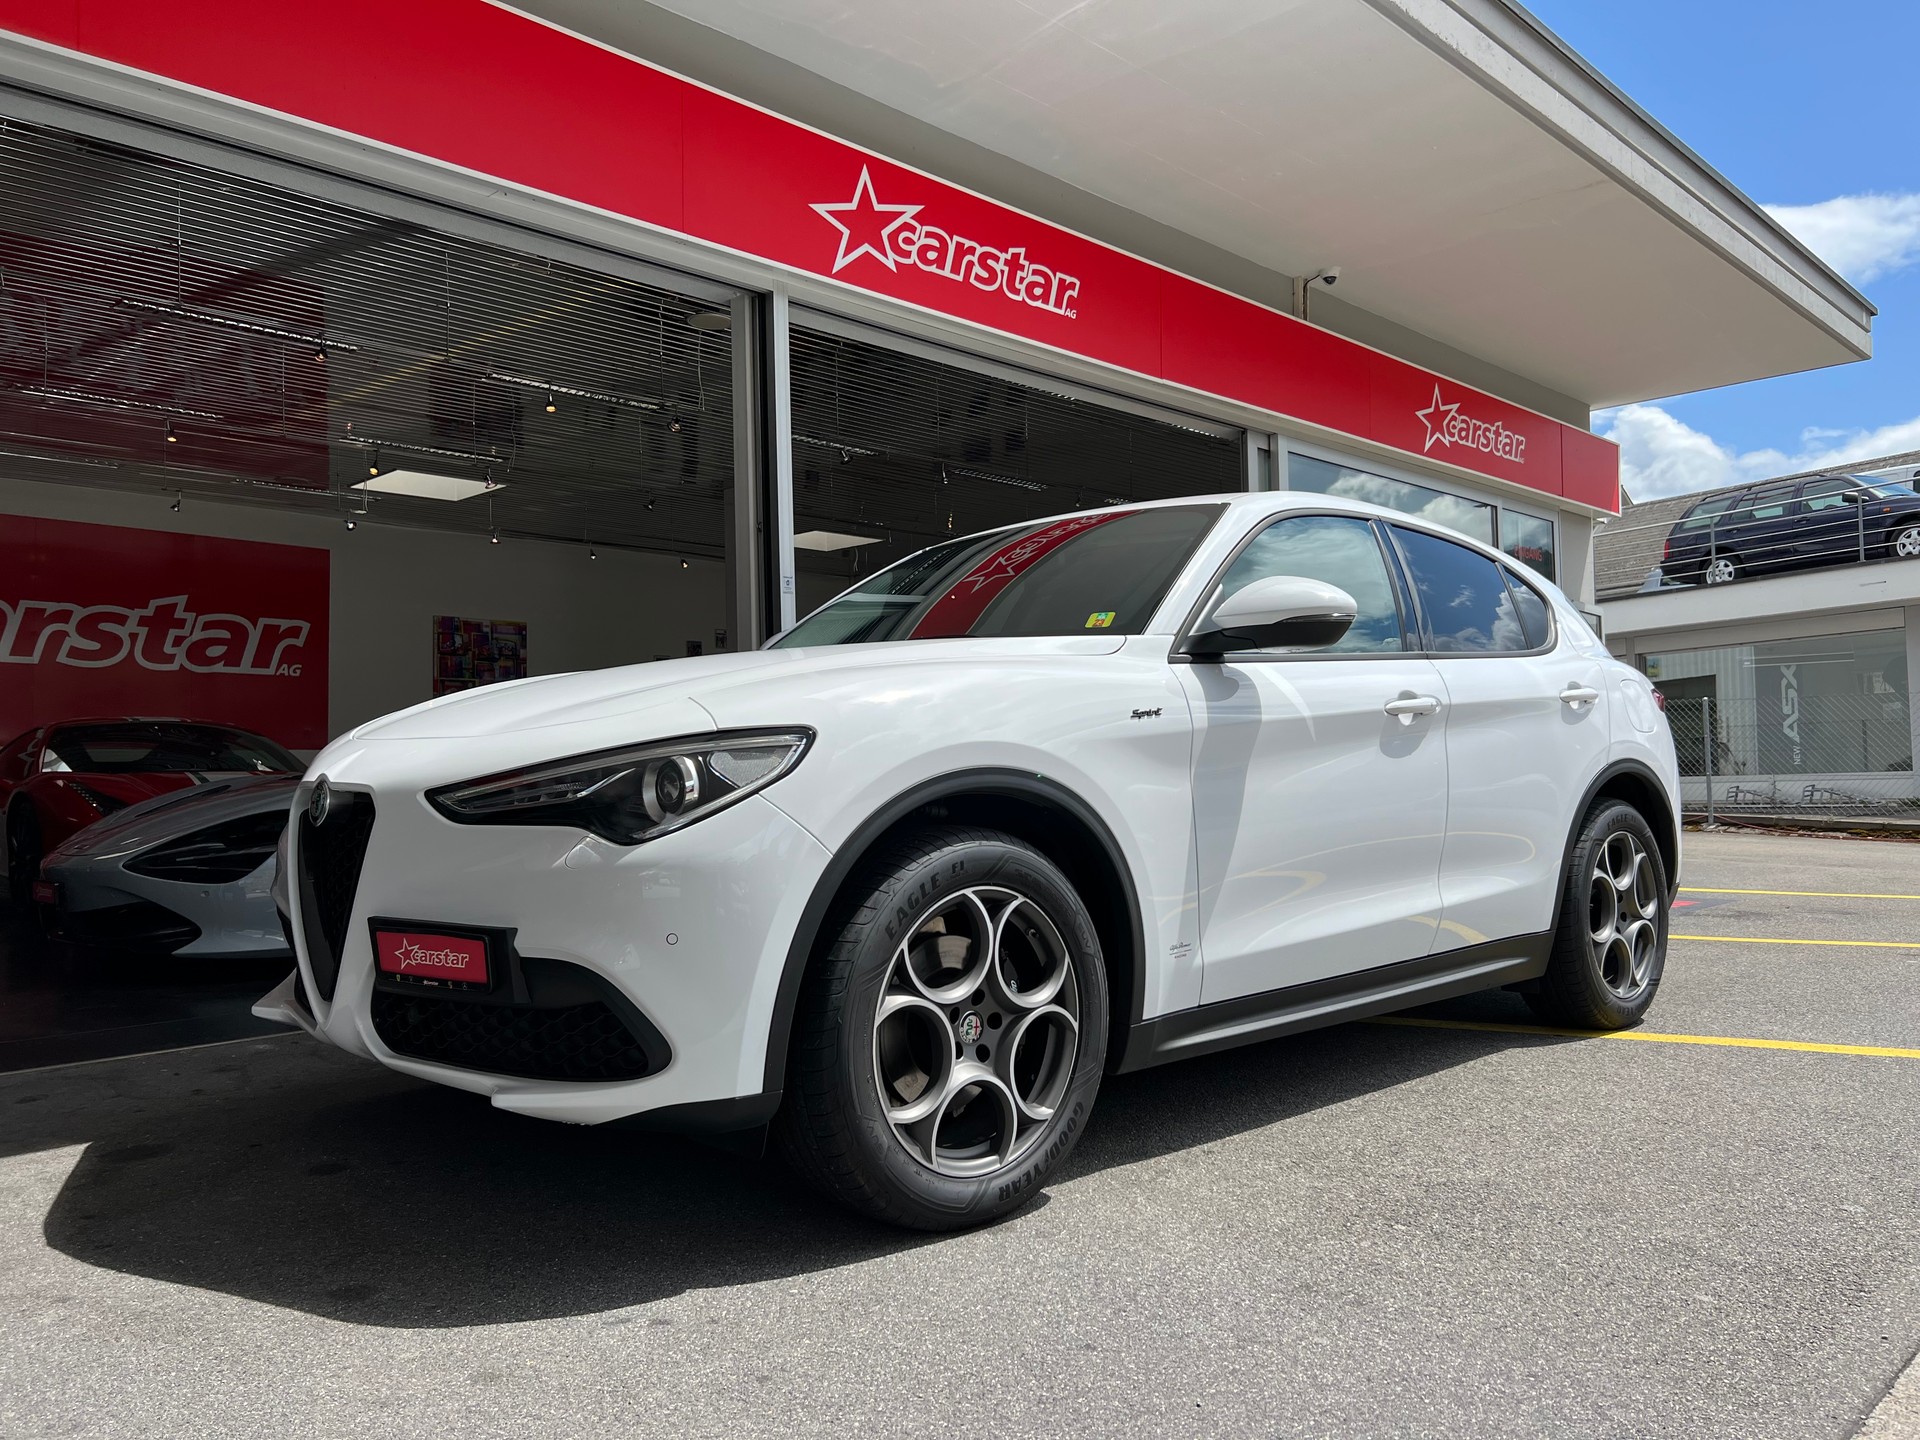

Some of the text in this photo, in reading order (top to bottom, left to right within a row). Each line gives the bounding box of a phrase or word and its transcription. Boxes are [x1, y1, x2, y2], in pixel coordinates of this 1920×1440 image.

[888, 217, 1080, 319] carstar AG
[1446, 413, 1526, 462] carstar
[0, 594, 311, 676] rstar AG
[1780, 664, 1801, 765] NEW ASX
[885, 872, 940, 941] EAGLE
[412, 948, 469, 968] carstar
[998, 1101, 1084, 1201] GOODYEAR
